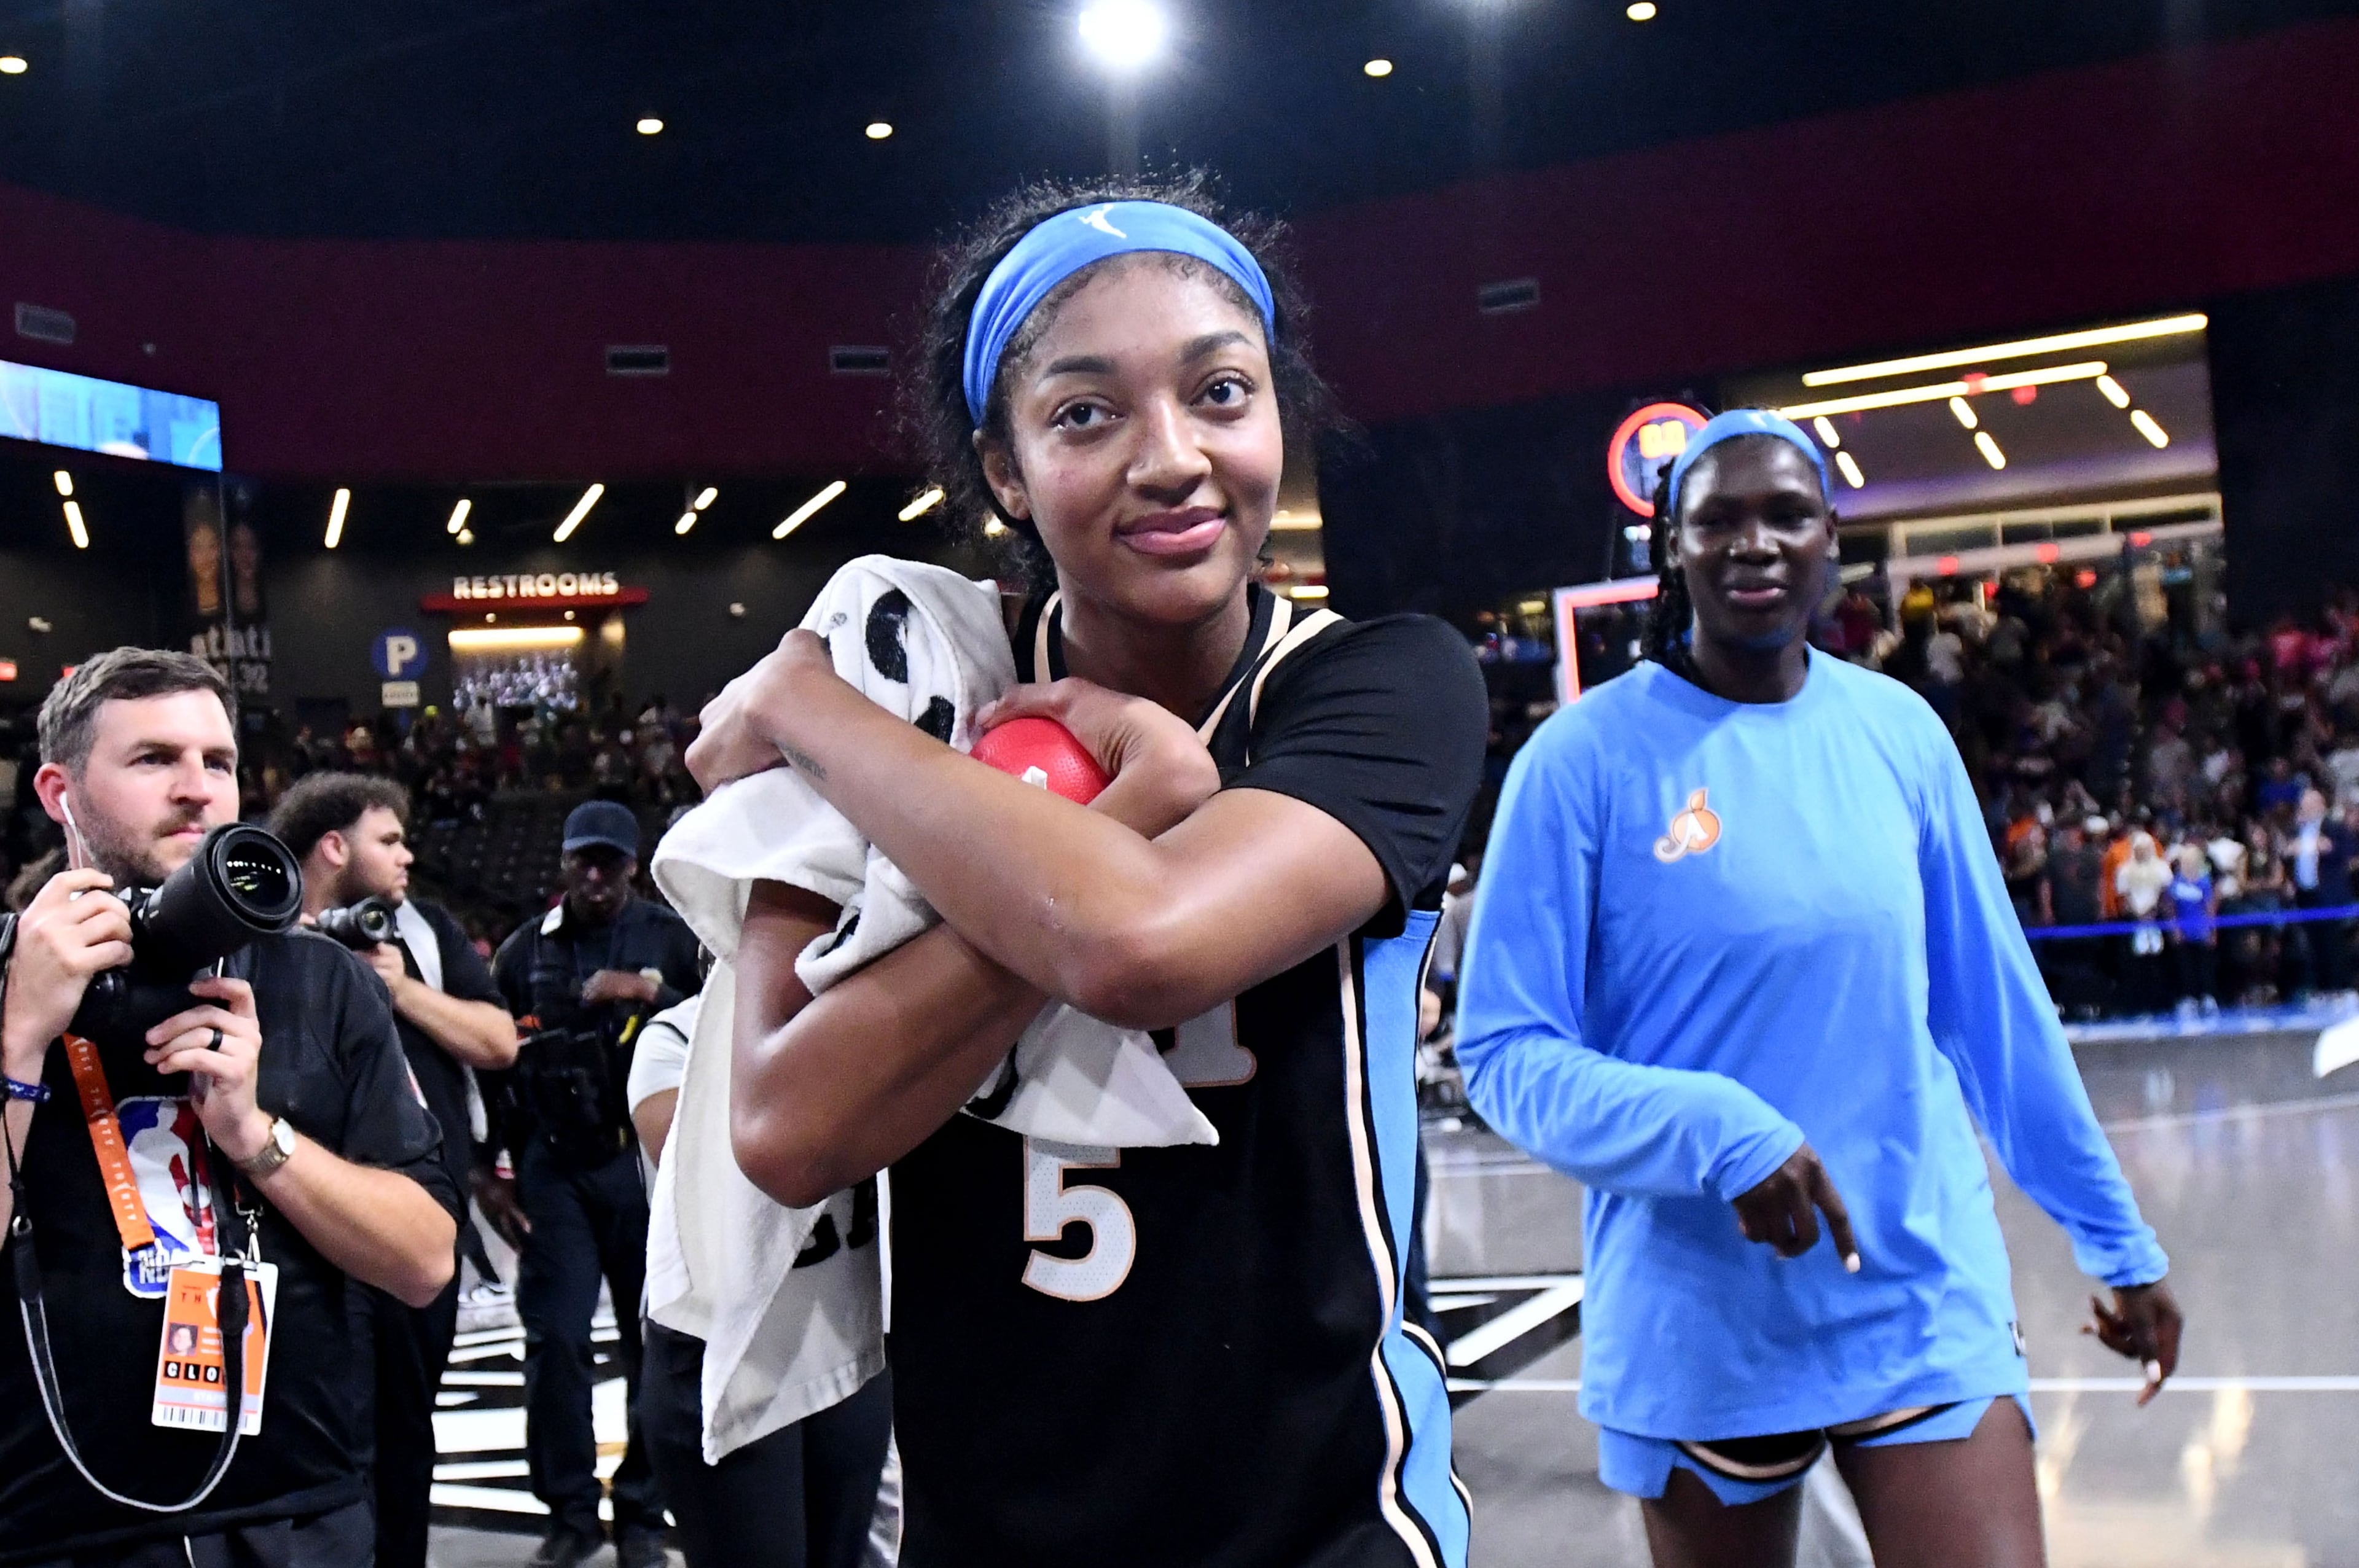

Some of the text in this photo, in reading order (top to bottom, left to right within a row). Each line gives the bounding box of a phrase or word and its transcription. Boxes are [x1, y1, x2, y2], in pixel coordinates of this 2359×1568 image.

[453, 571, 620, 599] RESTROOMS
[386, 636, 418, 676] P
[1020, 1135, 1136, 1302] 5
